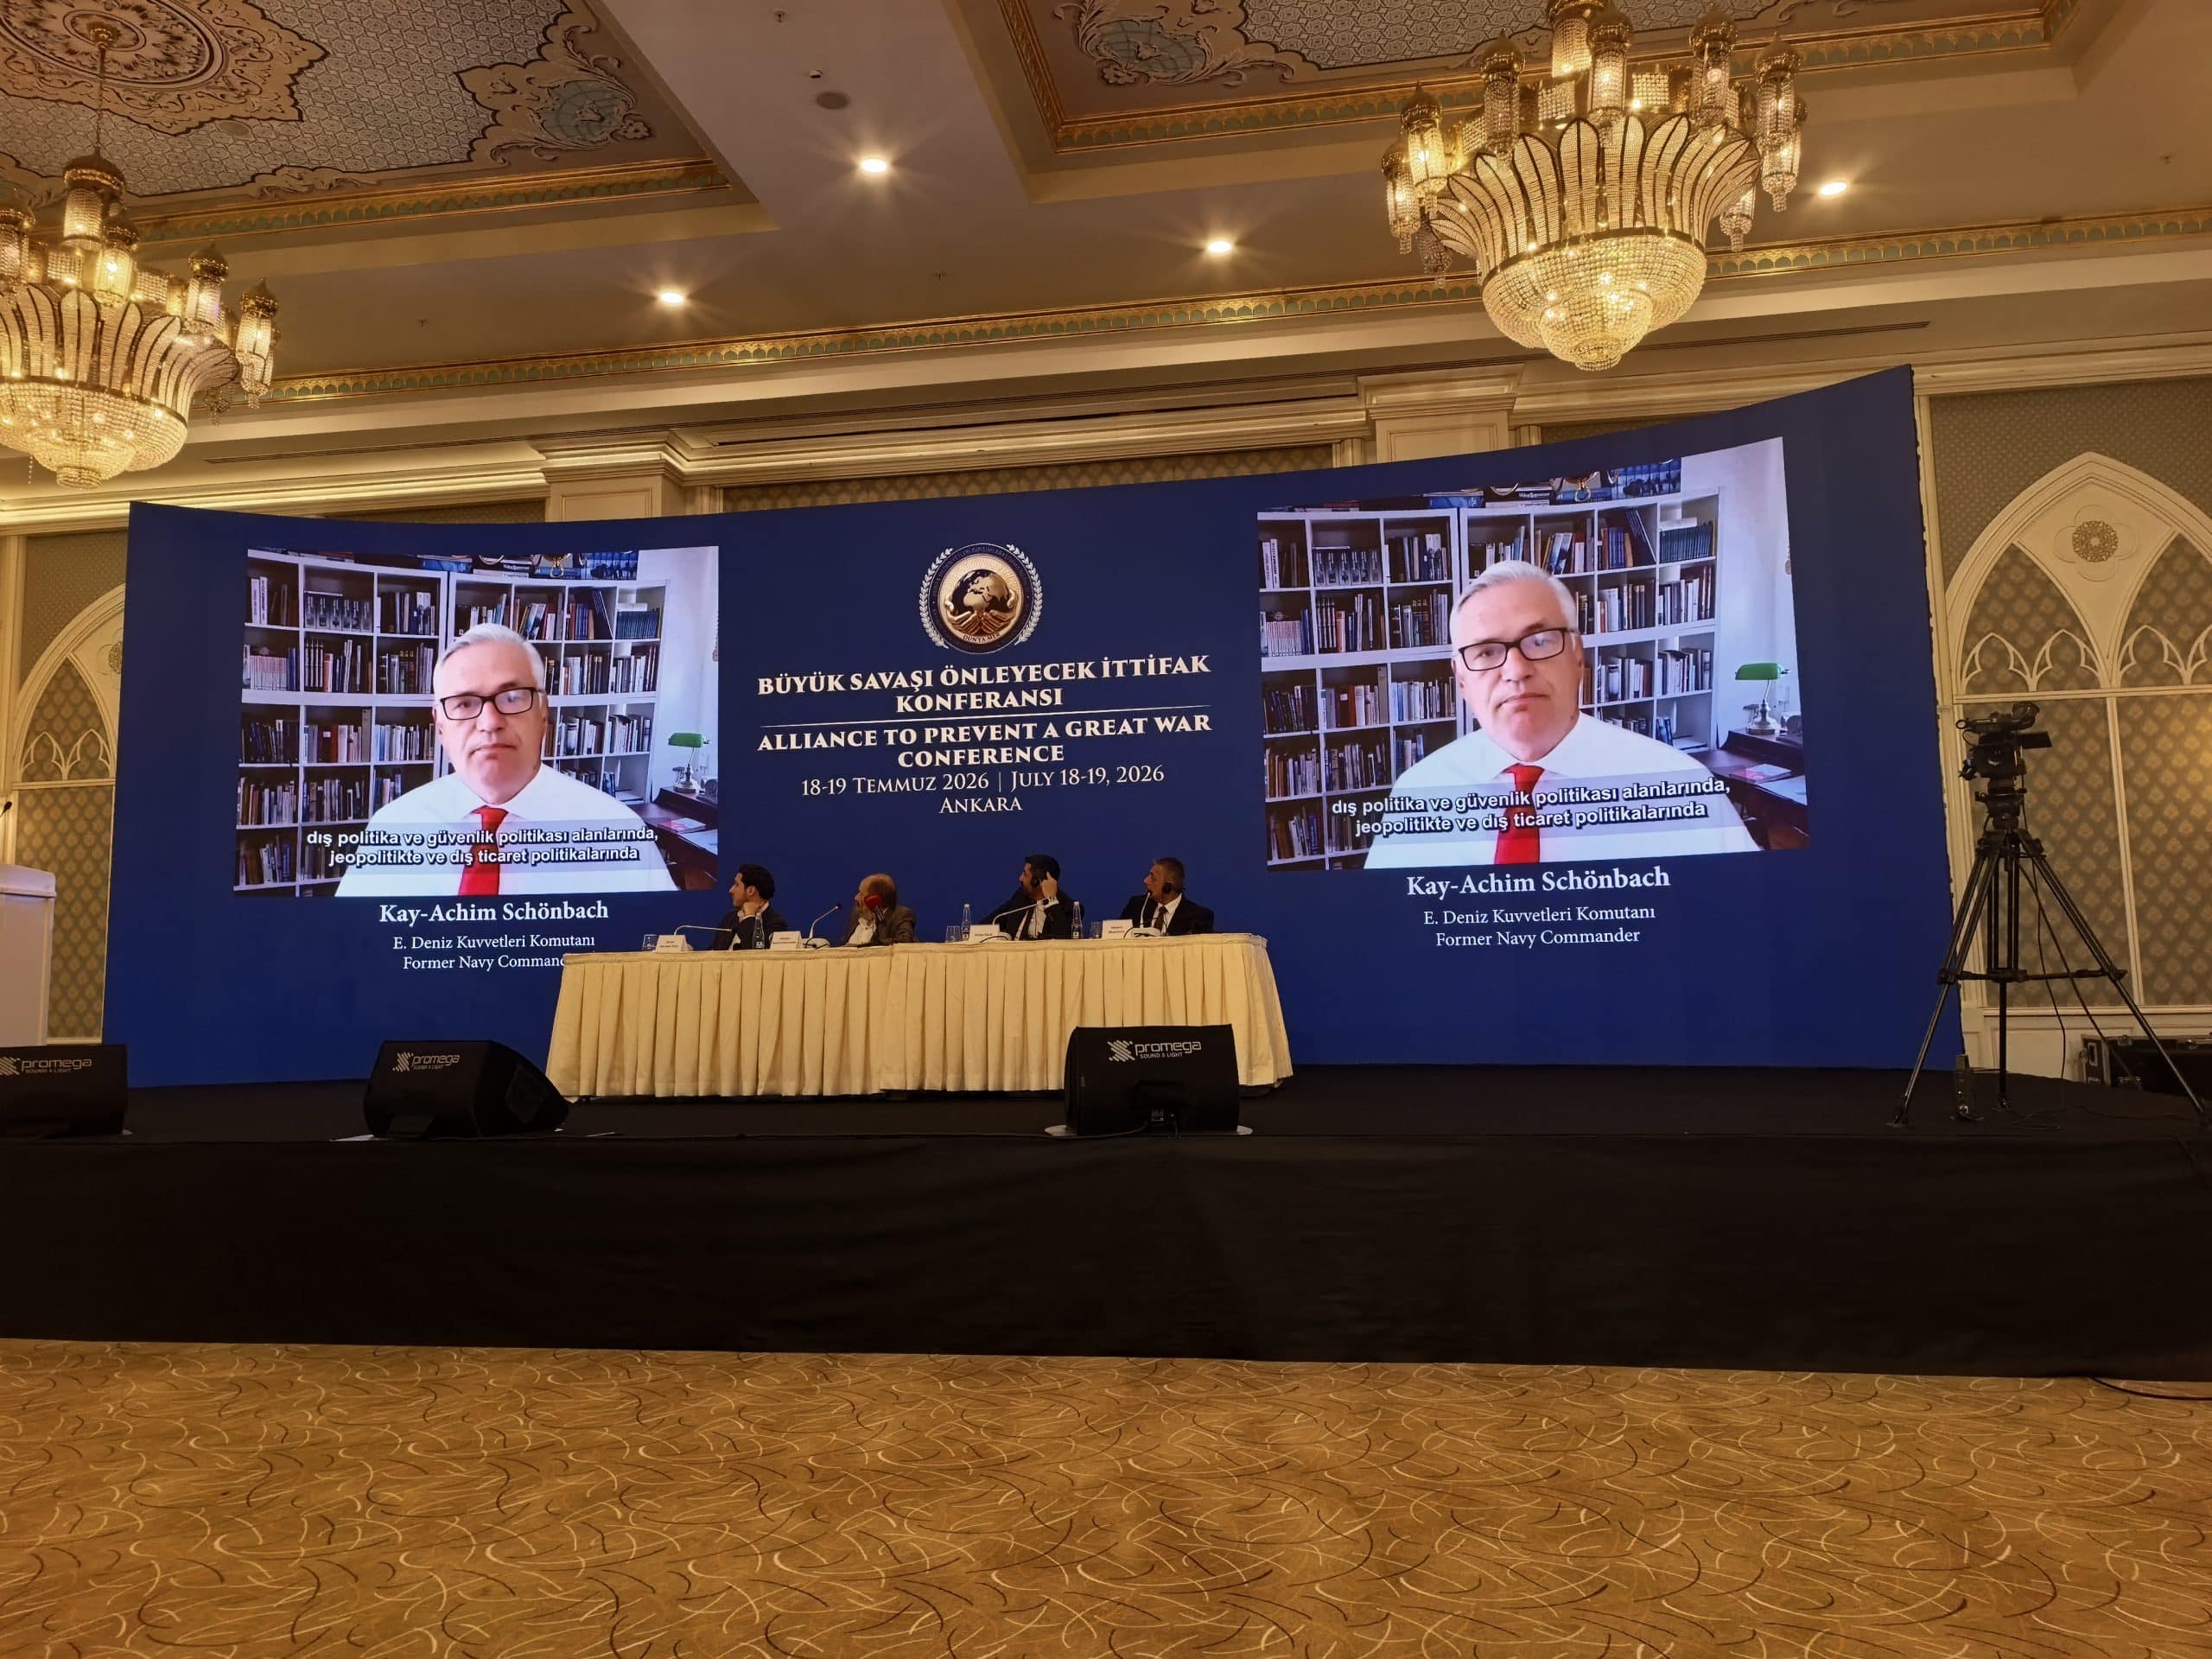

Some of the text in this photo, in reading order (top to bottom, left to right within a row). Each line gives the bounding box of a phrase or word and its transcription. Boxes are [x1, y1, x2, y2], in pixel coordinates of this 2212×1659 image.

[758, 653, 1211, 695] BÜYÜK SAVAŞI ÖNLEYECEK İTTİFAK
[896, 688, 1064, 713] KONFERANSI
[757, 715, 1212, 751] ALLIANCE TO PREVENT A GREAT WAR
[898, 745, 1065, 768] CONFERENCE
[802, 778, 847, 796] 18-19
[852, 776, 937, 793] TEMMUZ
[943, 772, 989, 790] 2026
[1011, 771, 1054, 792] JULY
[1061, 767, 1109, 786] 18-19,
[1116, 765, 1165, 783] 2026
[938, 797, 1023, 814] ANKARA
[1332, 779, 1731, 818] dış politika ve güvenlik politikası alanlarında,
[1355, 804, 1707, 838] jeopolitikte ve dış ticaret politikalarında
[307, 825, 659, 849] dış politika ve güvenlik politikası alanlarında,
[327, 846, 639, 867] jeopolitikte ve dış ticaret politikalarında
[1407, 865, 1671, 900] Kay-Achim Schönbach
[379, 899, 609, 927] Kay-Achim Schönbach
[1423, 906, 1656, 925] E. Deniz Kuvvetleri Komutanı
[393, 934, 595, 950] E. Deniz Kuvvetleri Komutanı
[1436, 927, 1641, 949] Former Navy Commander
[403, 957, 455, 969] Former
[459, 956, 494, 972] Navy
[411, 1054, 461, 1066] promega
[1135, 1041, 1202, 1056] promega
[22, 1058, 92, 1072] promega
